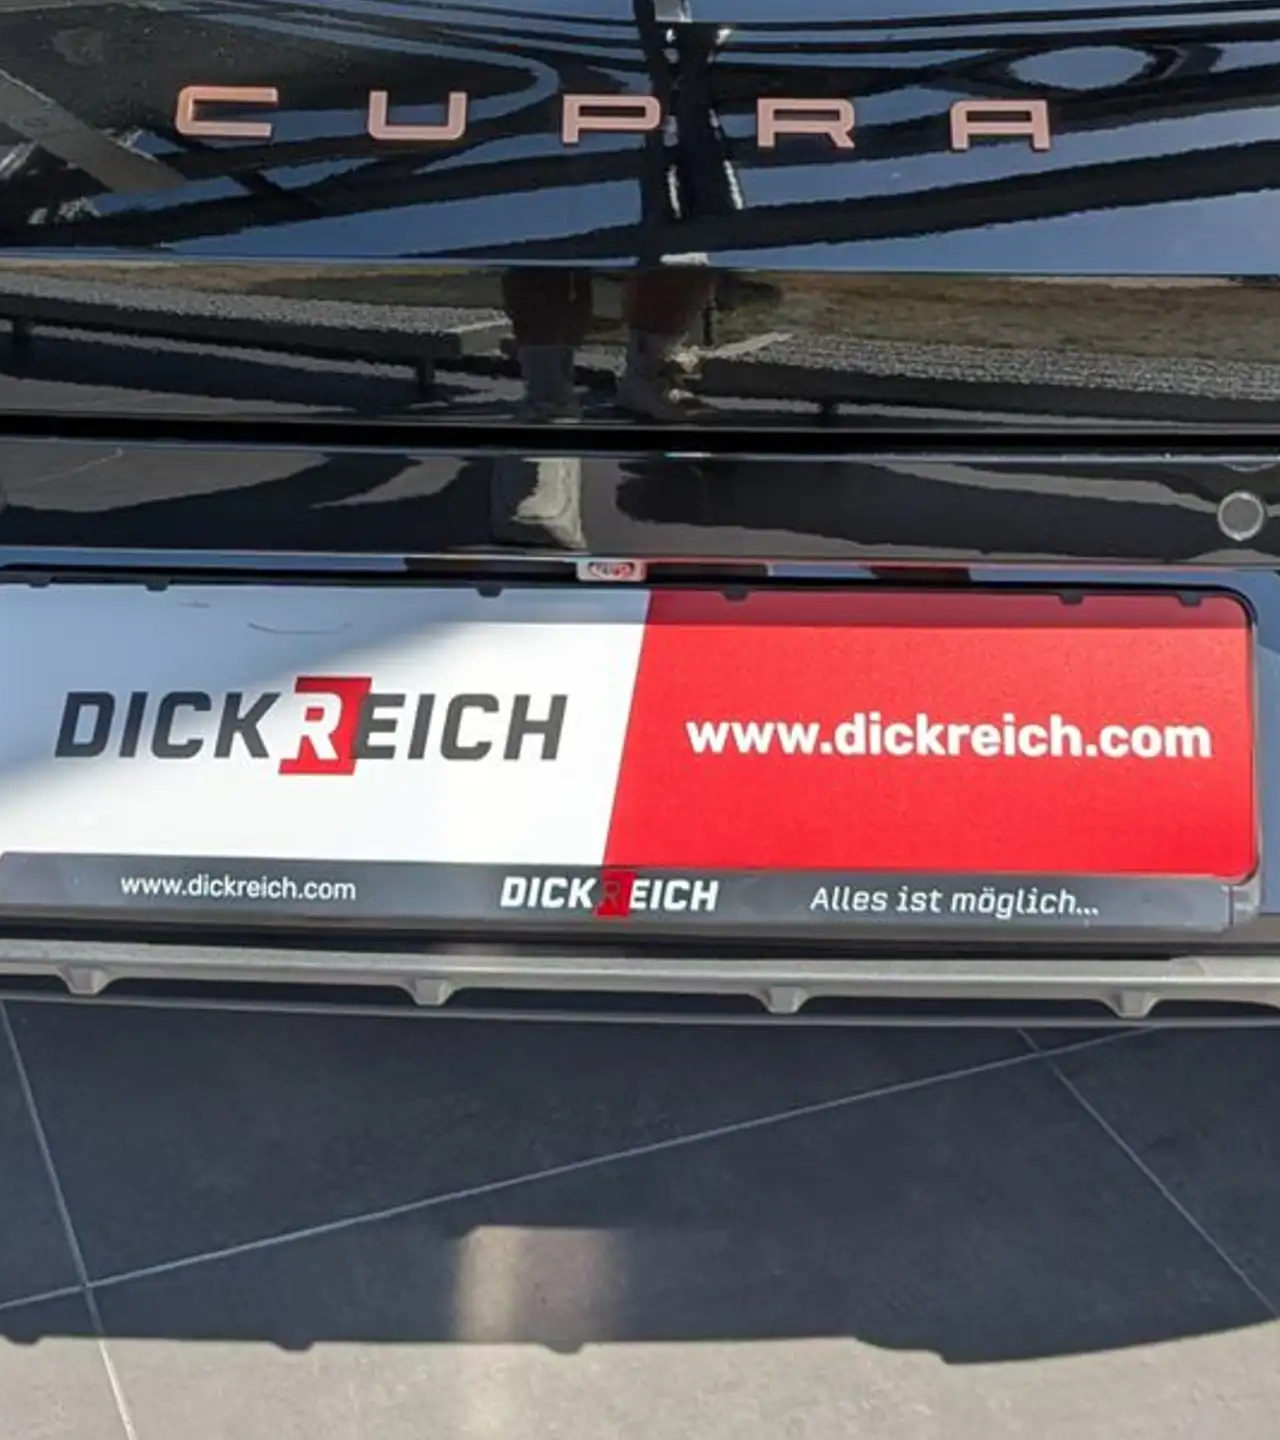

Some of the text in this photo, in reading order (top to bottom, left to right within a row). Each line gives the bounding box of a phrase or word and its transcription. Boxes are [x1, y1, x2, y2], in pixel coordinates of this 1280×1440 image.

[175, 85, 1054, 152] CUPRA
[55, 689, 568, 763] DICKREICH
[685, 712, 1213, 760] www.dickreich.com
[120, 873, 357, 902] www.dickreich.com
[499, 874, 719, 915] DICKREICH
[810, 885, 1100, 921] Alles ist möglich...
